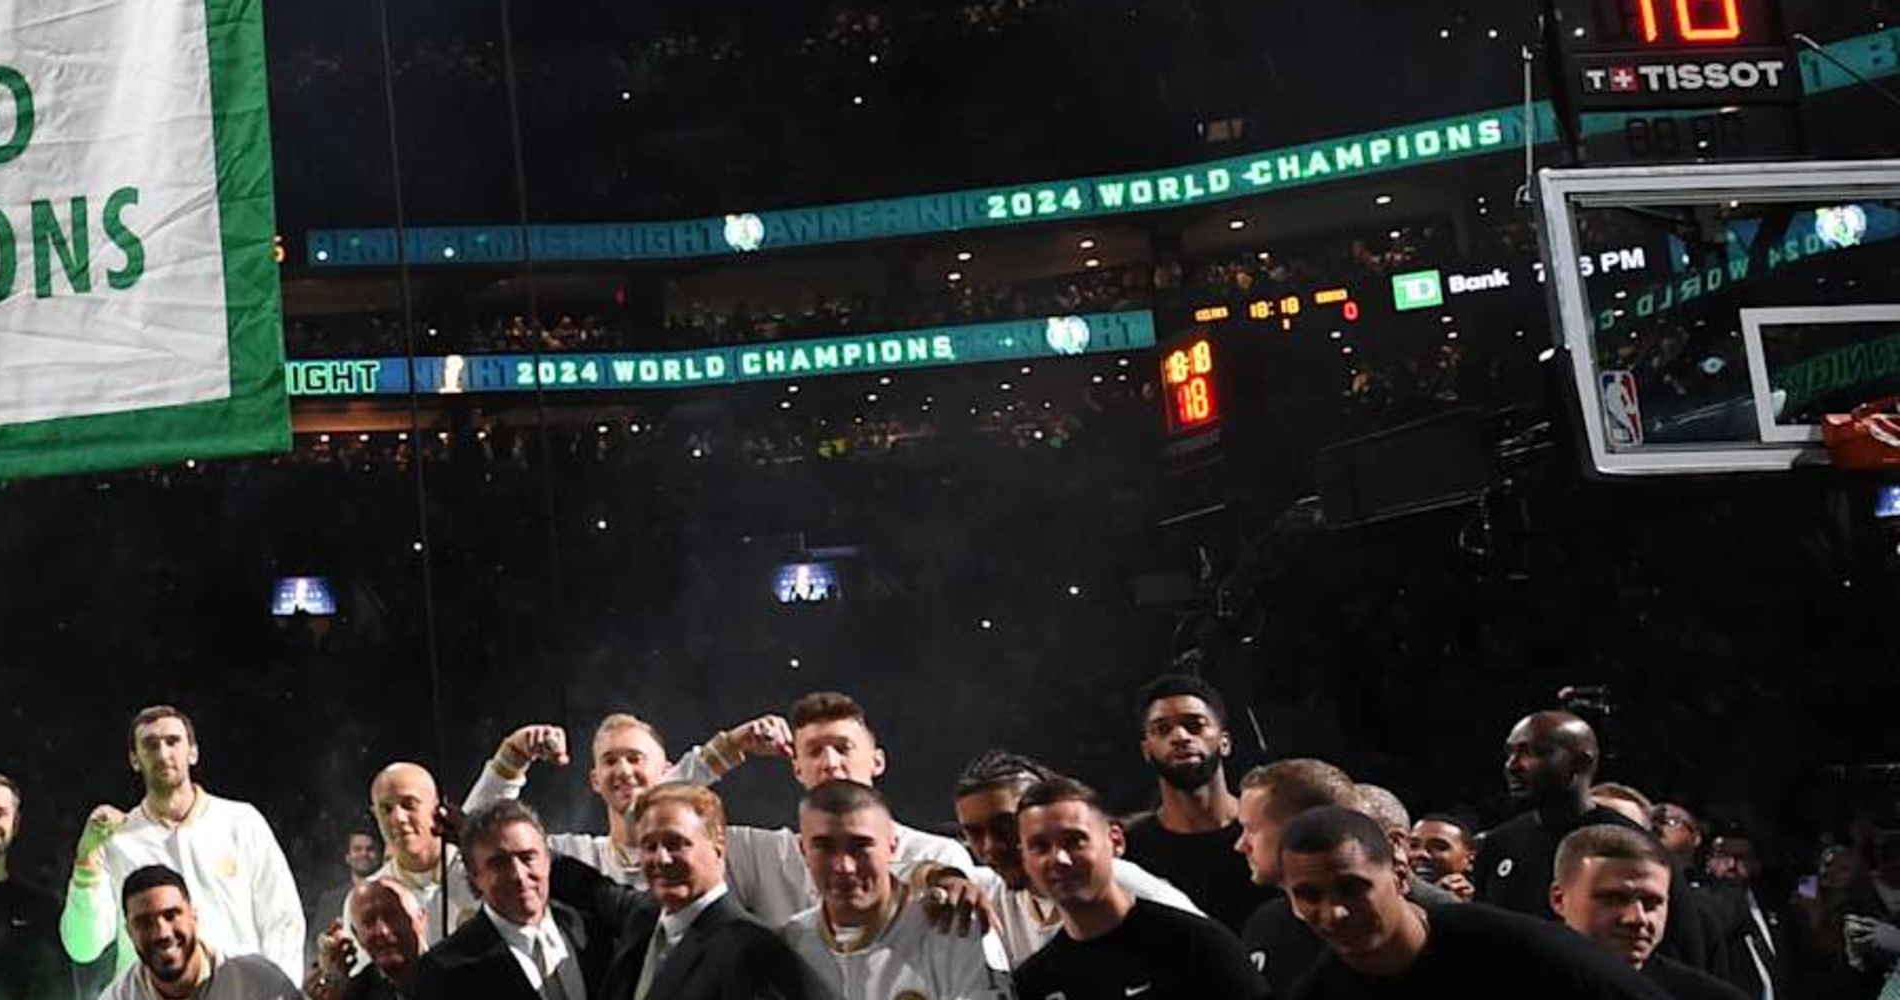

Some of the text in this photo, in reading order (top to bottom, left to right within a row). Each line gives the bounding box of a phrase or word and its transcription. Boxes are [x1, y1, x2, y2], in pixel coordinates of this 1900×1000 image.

[1639, 62, 1784, 91] TISSOT
[986, 185, 1083, 219] 2024
[1097, 167, 1230, 208] WORLD
[1246, 118, 1502, 185] CHAMPIONS
[1599, 247, 1646, 273] PM
[1402, 267, 1511, 302] TD Bank
[1343, 301, 1358, 320] 0
[285, 358, 381, 395] IGHT
[515, 360, 598, 385] 2024
[612, 355, 725, 383] WORLD
[741, 336, 953, 374] CHAMPIONS
